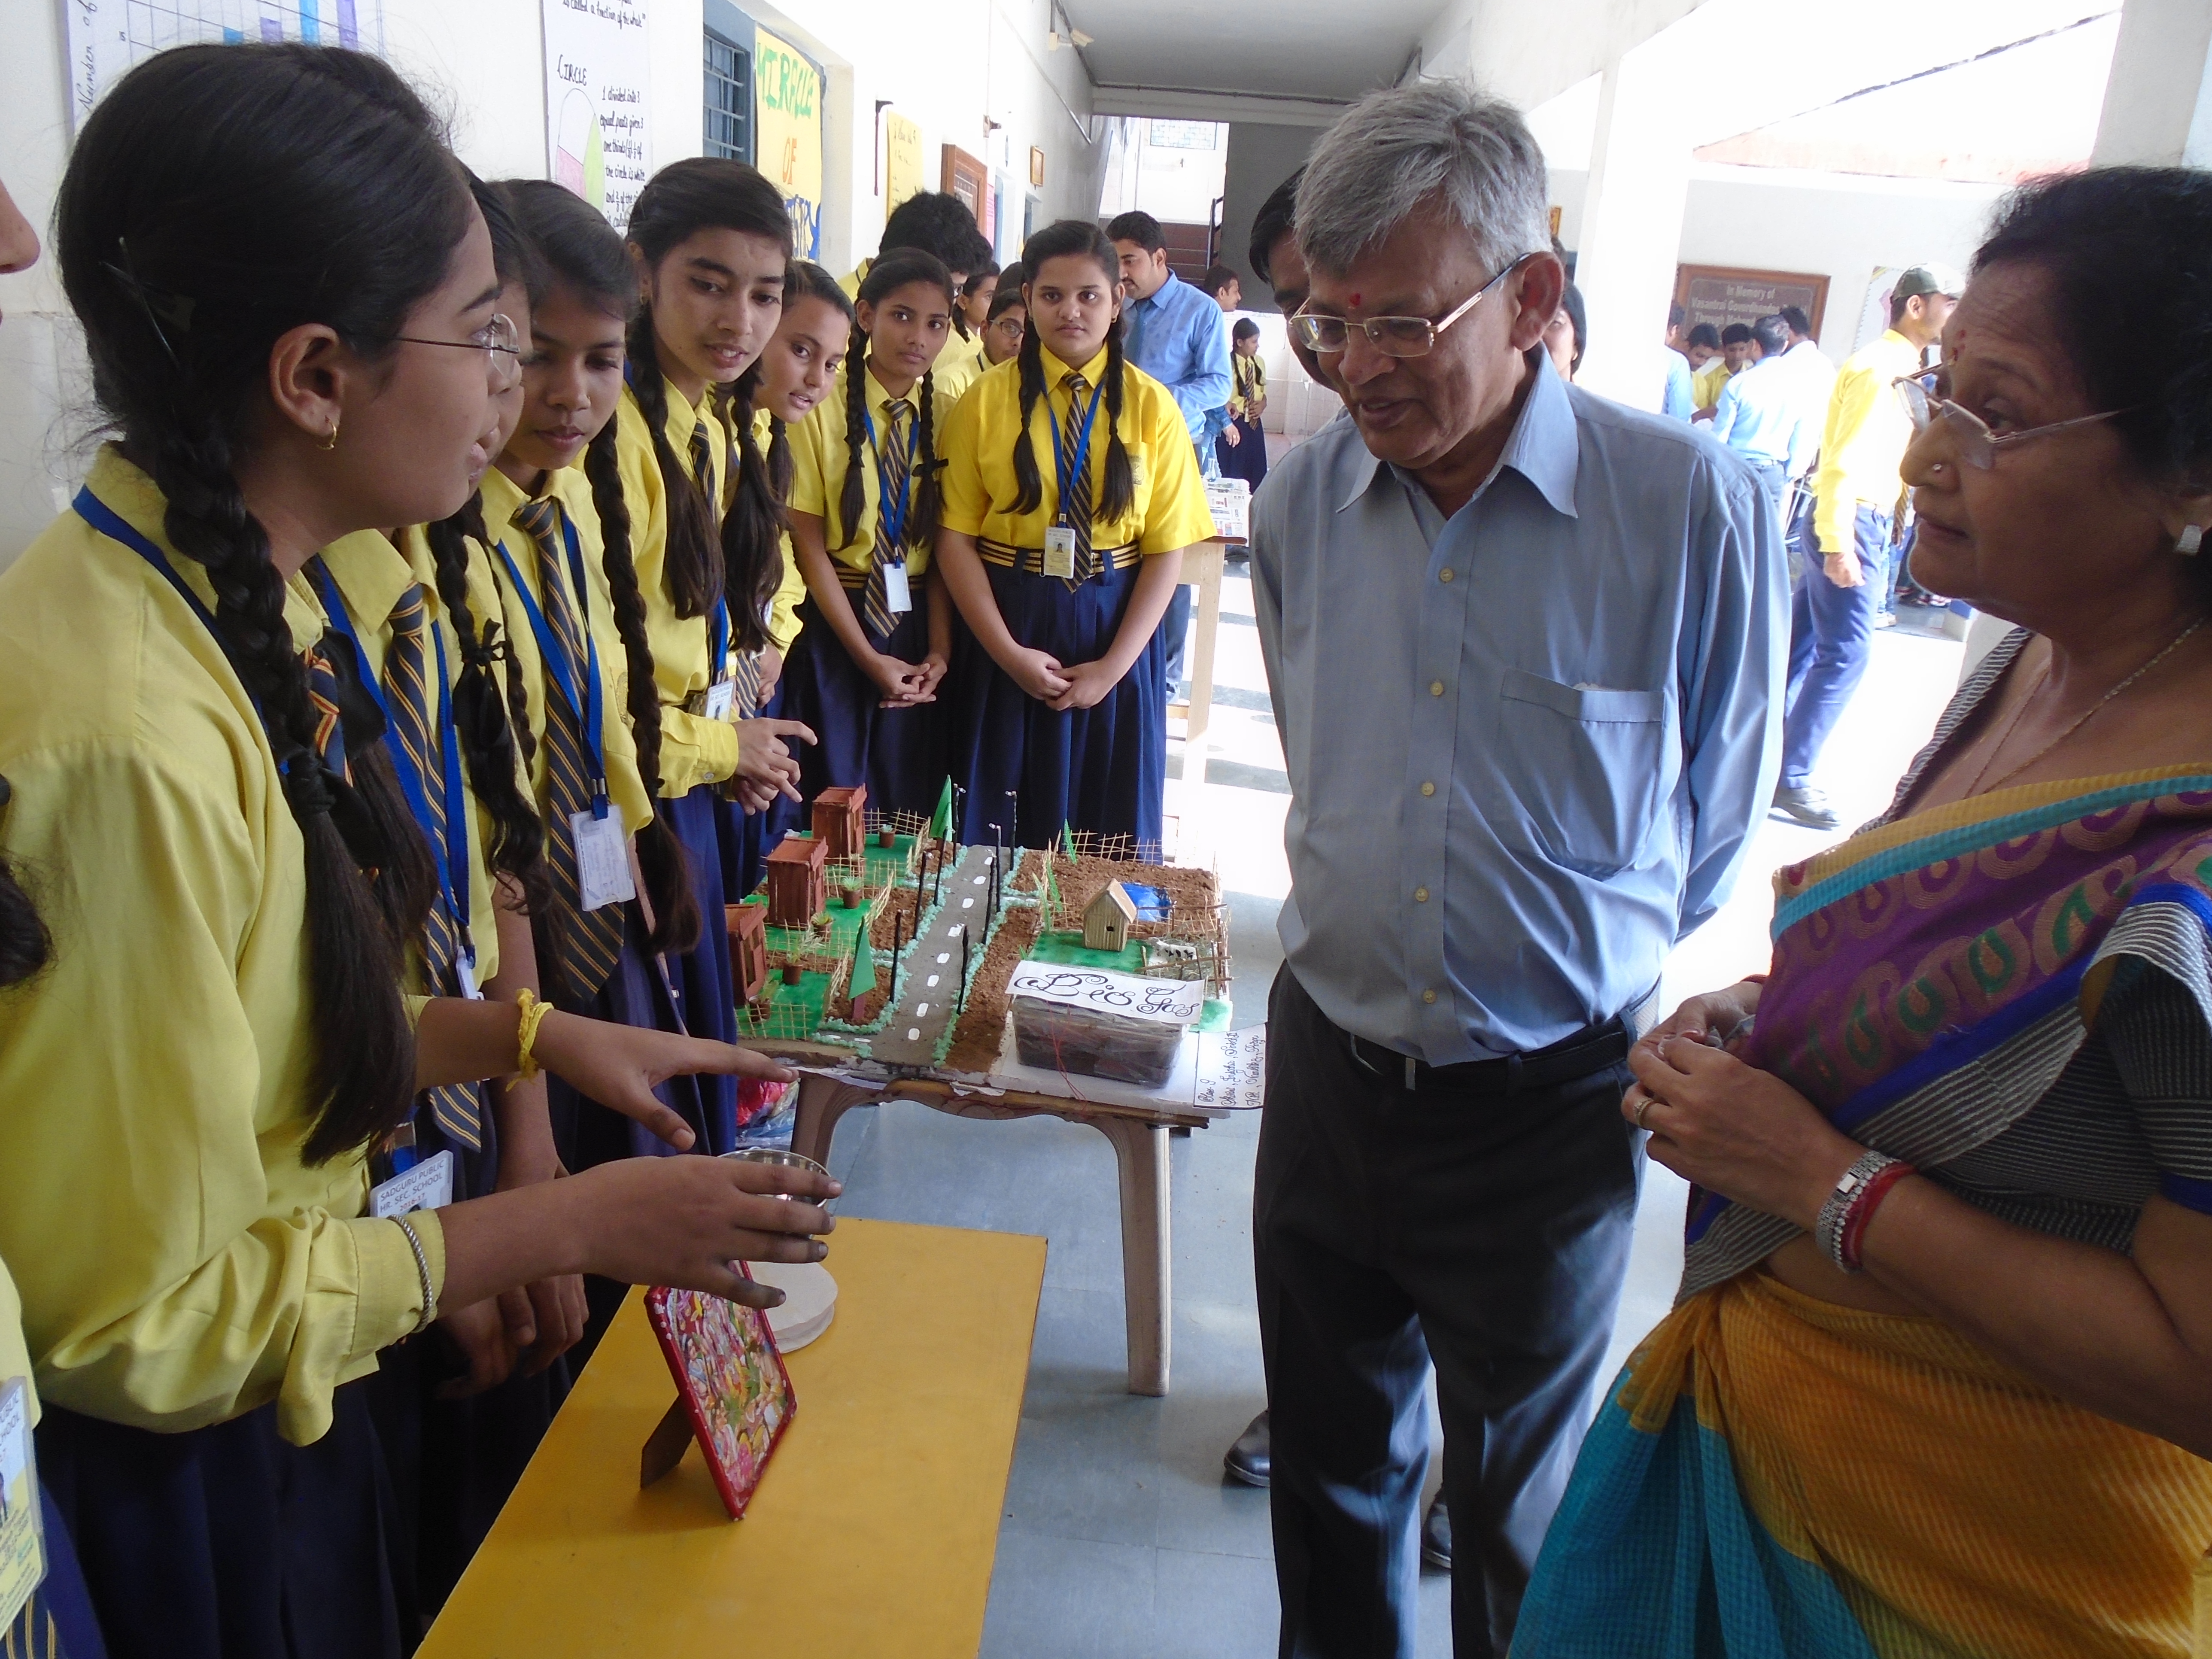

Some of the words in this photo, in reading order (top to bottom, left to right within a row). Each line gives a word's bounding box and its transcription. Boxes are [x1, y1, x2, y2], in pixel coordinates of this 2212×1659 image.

[557, 54, 586, 86] CIRCLE
[757, 42, 814, 120] MIRACLE
[782, 137, 797, 185] OF
[1736, 286, 1766, 301] Memory
[1767, 288, 1776, 299] of
[1014, 973, 1136, 1006] Bio
[1136, 984, 1200, 1017] Gas
[380, 1176, 417, 1202] SADGURU
[419, 1160, 444, 1179] PUBLIC
[380, 1202, 392, 1213] HR.
[395, 1191, 410, 1205] SEC.
[413, 1173, 443, 1195] SCHOOL
[400, 1193, 425, 1211] 2016-17
